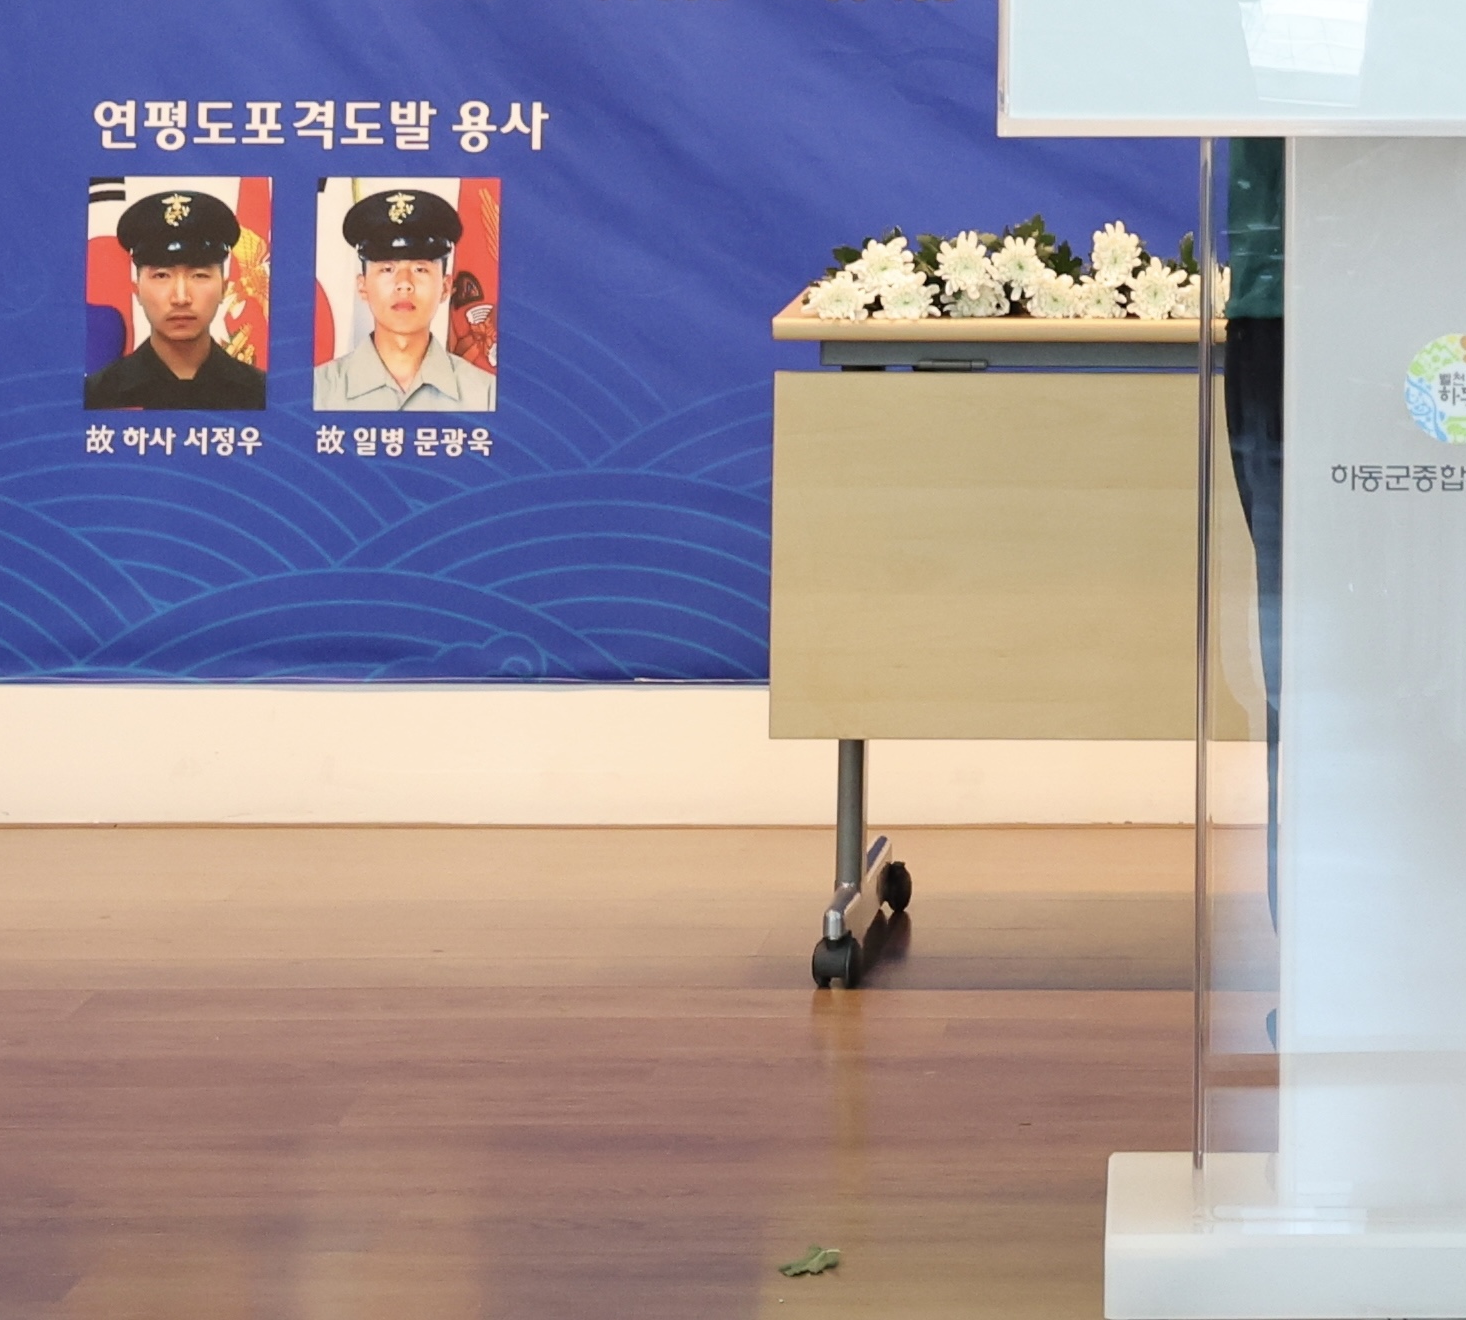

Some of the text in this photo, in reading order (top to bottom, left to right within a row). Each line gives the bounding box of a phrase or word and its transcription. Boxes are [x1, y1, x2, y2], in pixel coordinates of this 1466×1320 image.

[93, 100, 550, 153] 연평도포격도발 용사
[85, 424, 263, 456] 故 하사 서정우
[316, 424, 493, 457] 故 일병 문광욱
